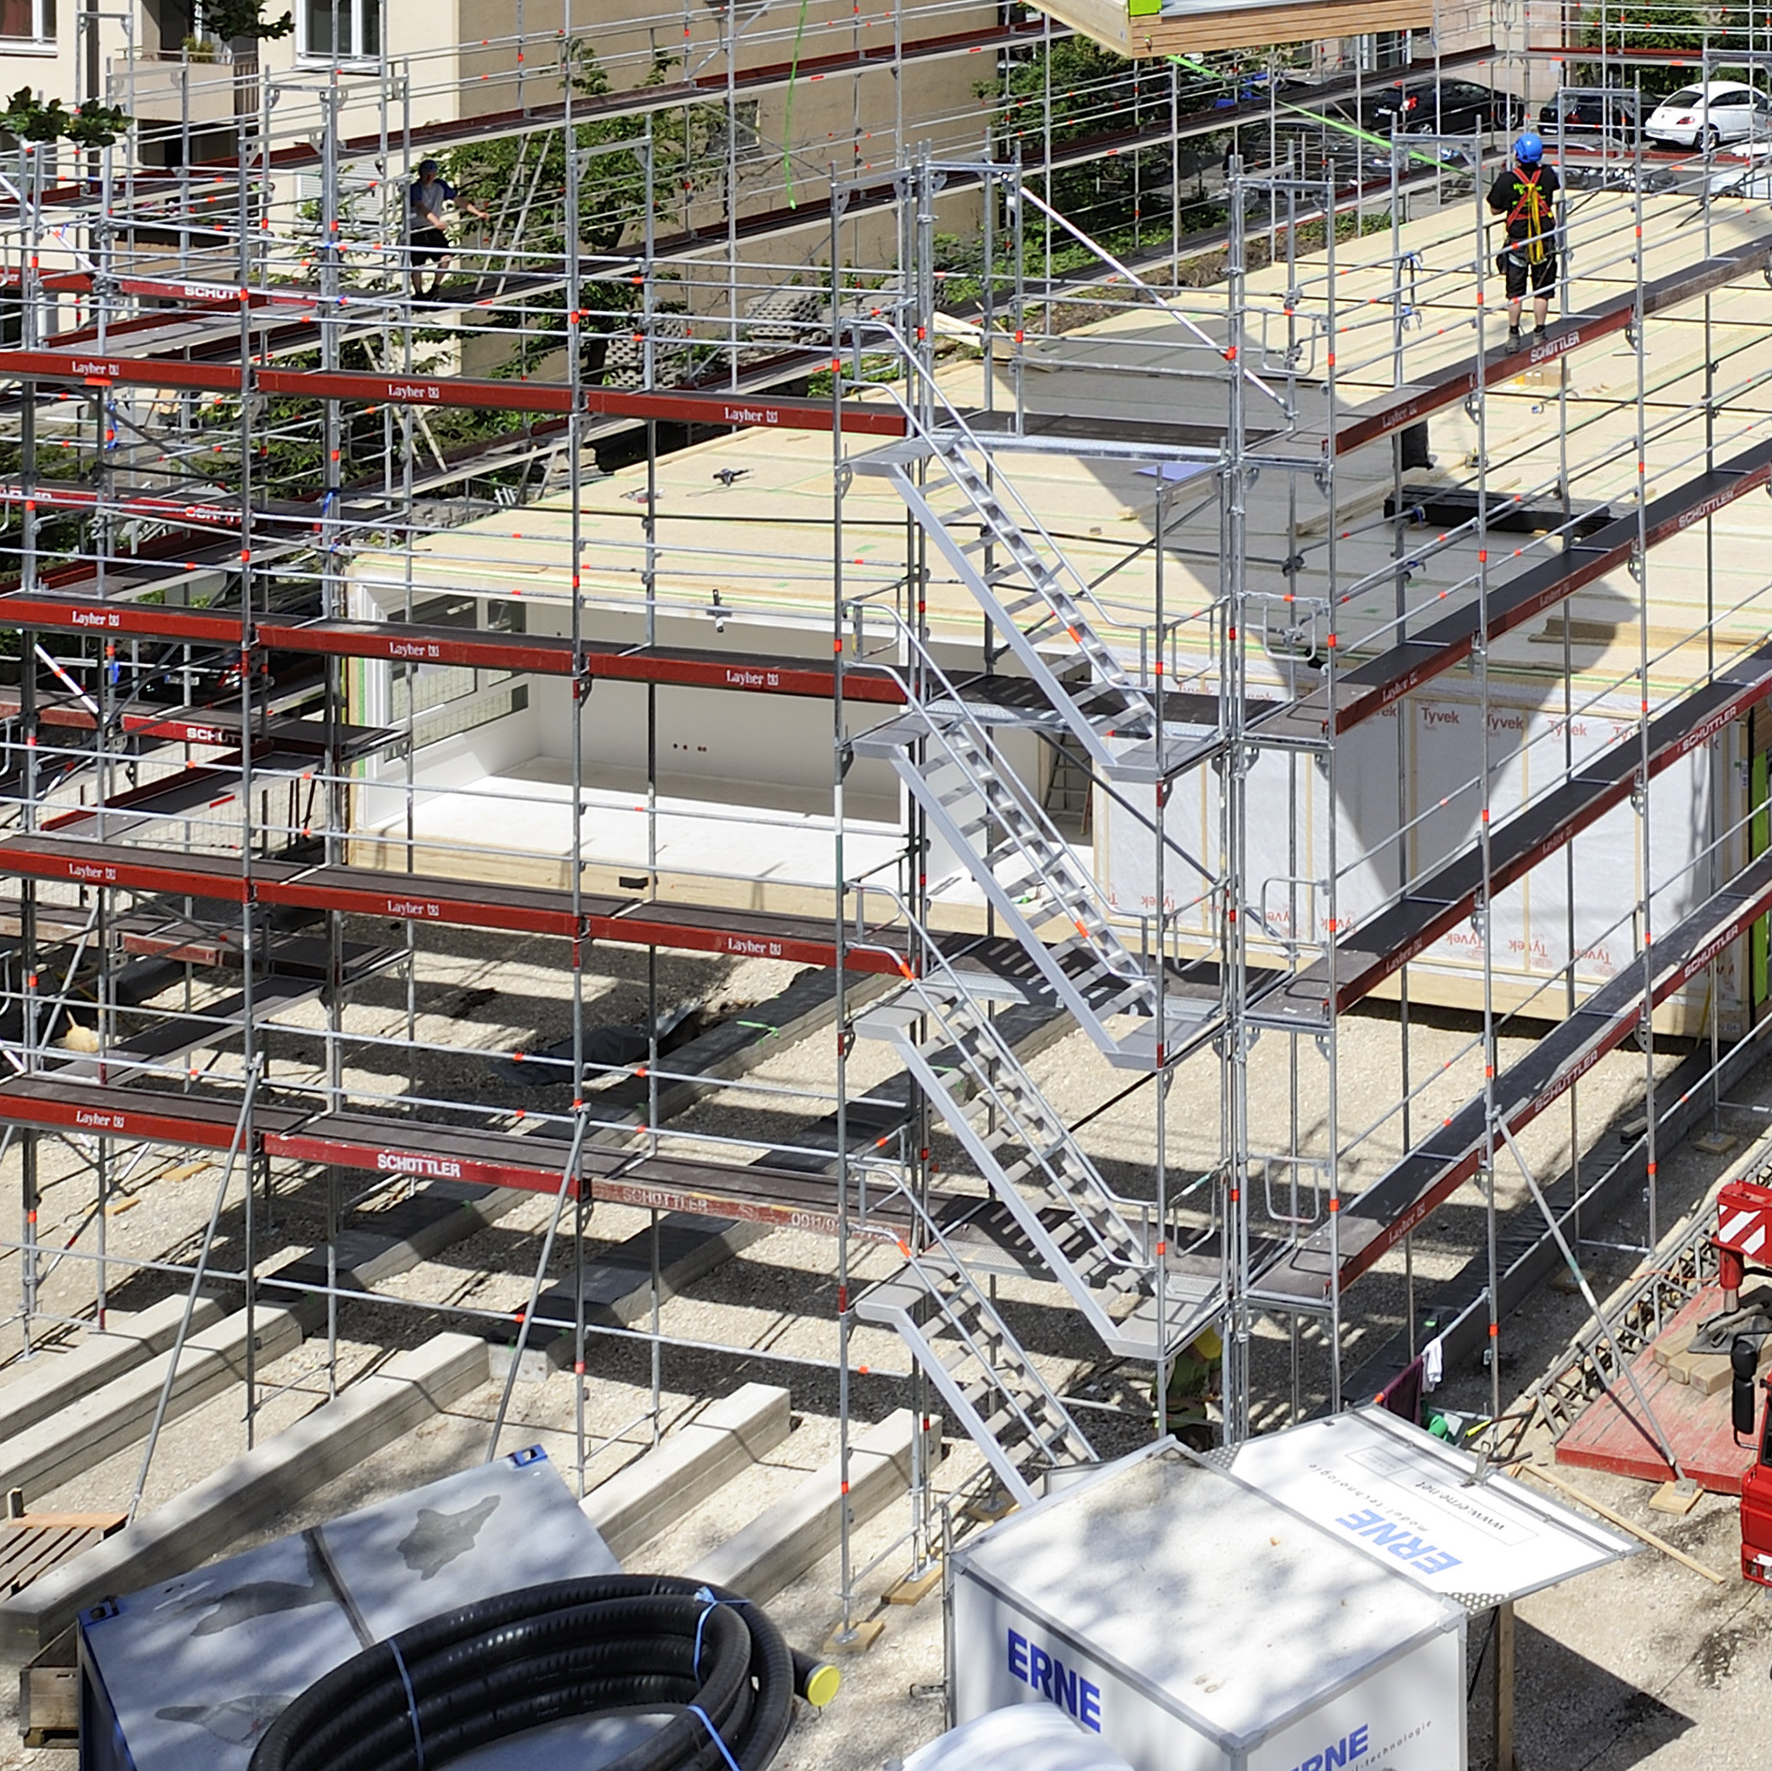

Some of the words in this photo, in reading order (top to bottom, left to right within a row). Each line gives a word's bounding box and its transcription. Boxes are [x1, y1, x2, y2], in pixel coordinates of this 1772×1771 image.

[72, 360, 107, 375] Layher
[388, 384, 425, 399] Layher
[724, 406, 763, 422] Layher
[72, 610, 107, 626] Layher
[389, 642, 425, 657] Layher
[726, 670, 764, 685] Layher
[1422, 707, 1460, 725] Tyvek
[1486, 714, 1525, 731] Tyvek
[1548, 719, 1588, 739] Tyek
[69, 863, 103, 878] Layher
[387, 900, 424, 915] Layher
[1141, 895, 1175, 912] Tyek
[728, 937, 767, 953] Layher
[77, 1111, 112, 1126] Layher
[1415, 1480, 1504, 1531] www.erne.net
[1335, 1508, 1463, 1574] ERNE
[1008, 1627, 1101, 1734] ERNE
[1293, 1723, 1368, 1771] RNE
